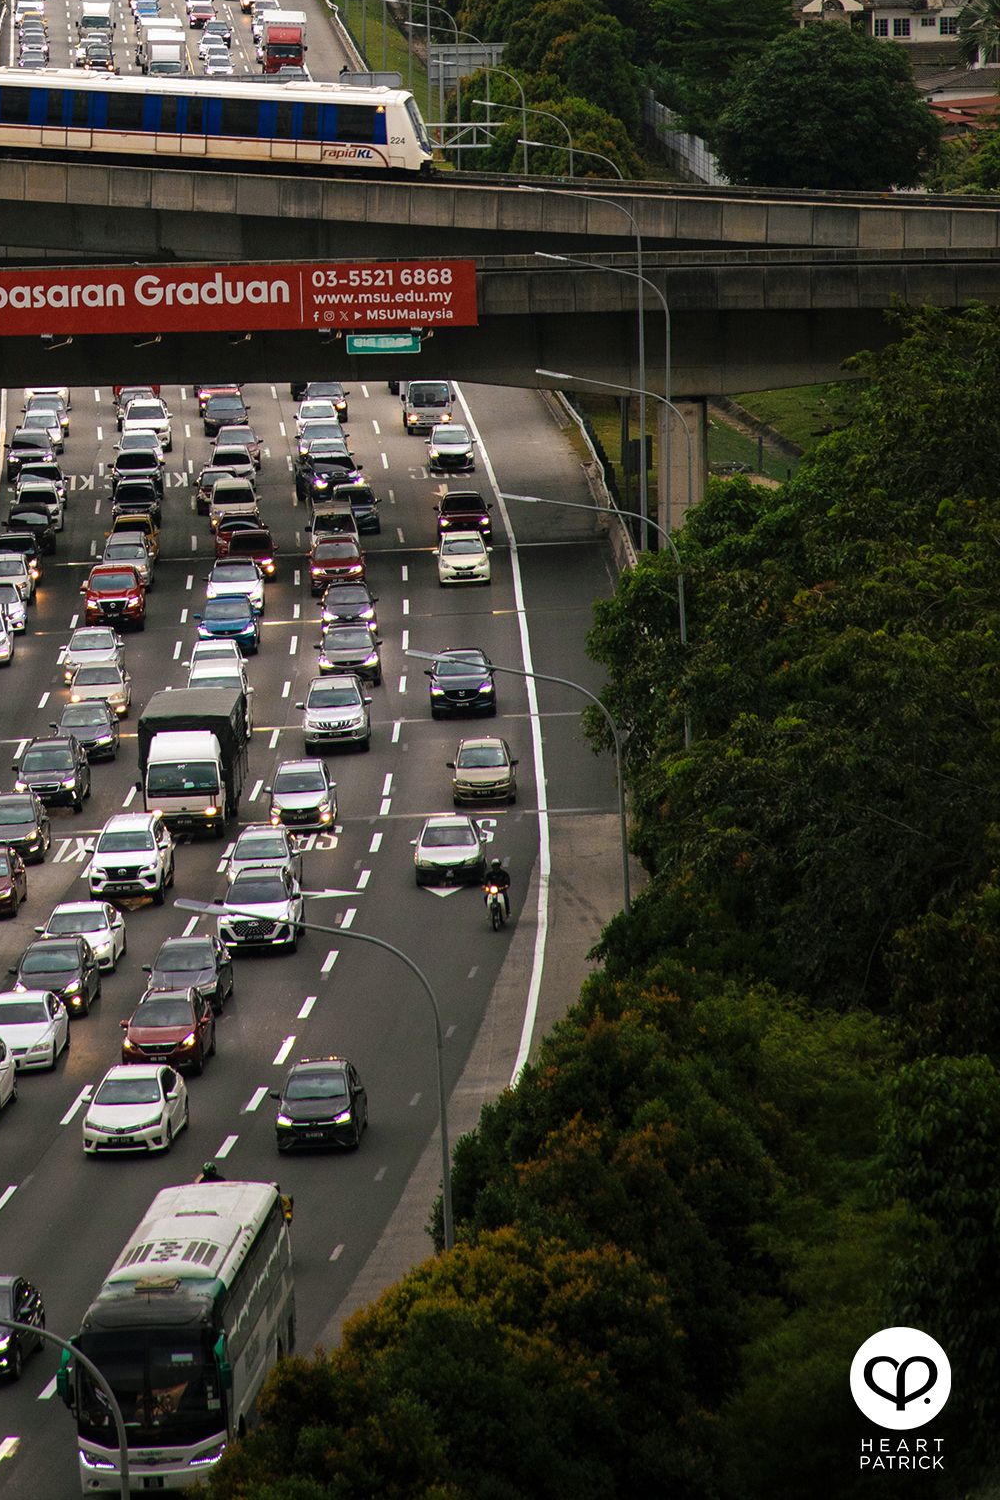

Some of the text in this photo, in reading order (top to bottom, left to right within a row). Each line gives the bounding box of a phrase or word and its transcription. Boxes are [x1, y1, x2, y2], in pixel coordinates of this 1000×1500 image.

[323, 148, 373, 160] rapidKL
[312, 268, 453, 288] 03-5521 6868
[134, 272, 290, 307] Graduan
[313, 290, 452, 305] www.msu.edu.my
[366, 308, 454, 322] MSUMalaysia
